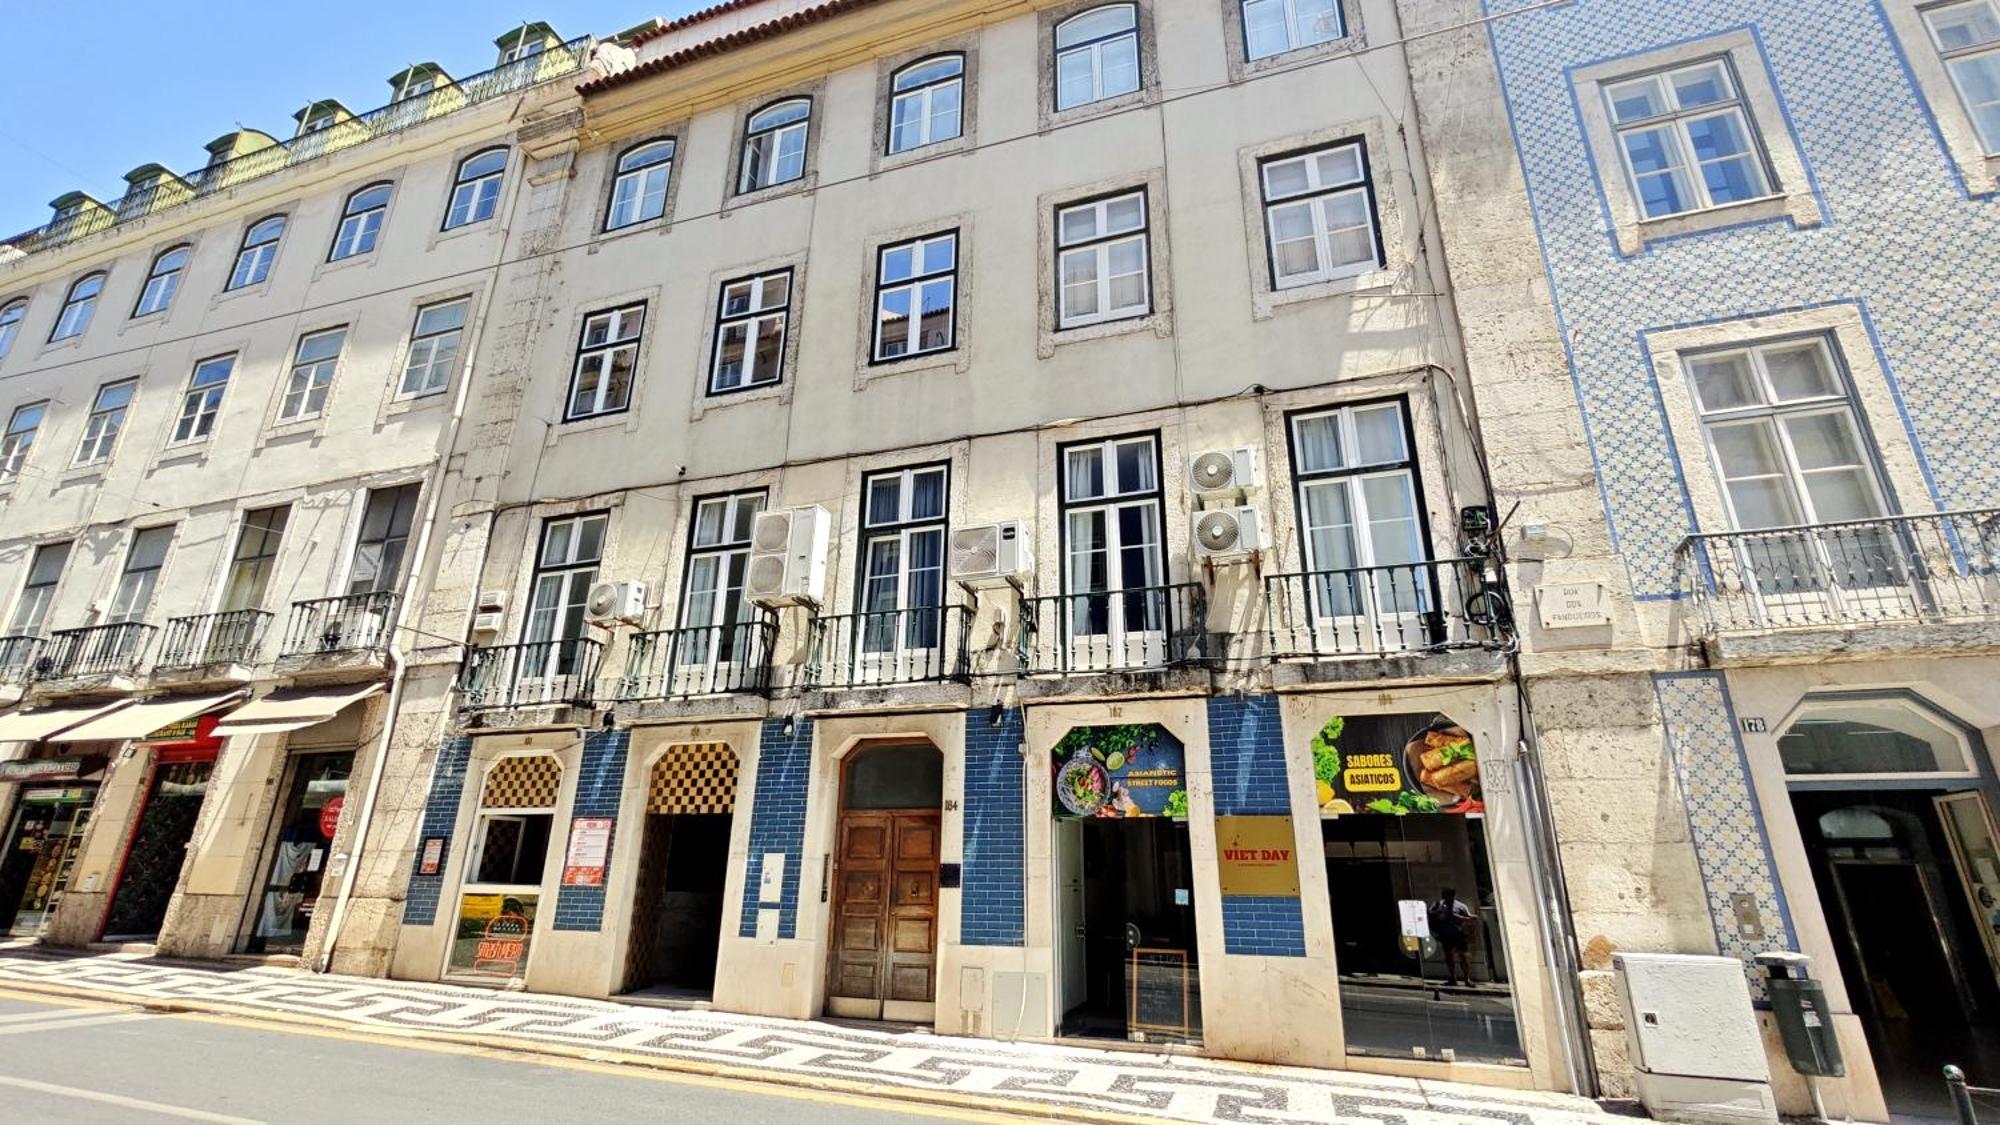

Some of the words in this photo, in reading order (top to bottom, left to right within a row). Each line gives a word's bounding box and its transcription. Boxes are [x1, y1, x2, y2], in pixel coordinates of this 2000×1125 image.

[1742, 718, 1765, 731] 178
[1346, 754, 1393, 767] SABORES
[1127, 779, 1152, 787] STREET
[1350, 773, 1396, 785] ASIATICOS
[944, 799, 958, 811] 184
[1223, 849, 1258, 861] VIET
[1261, 849, 1289, 861] DAY
